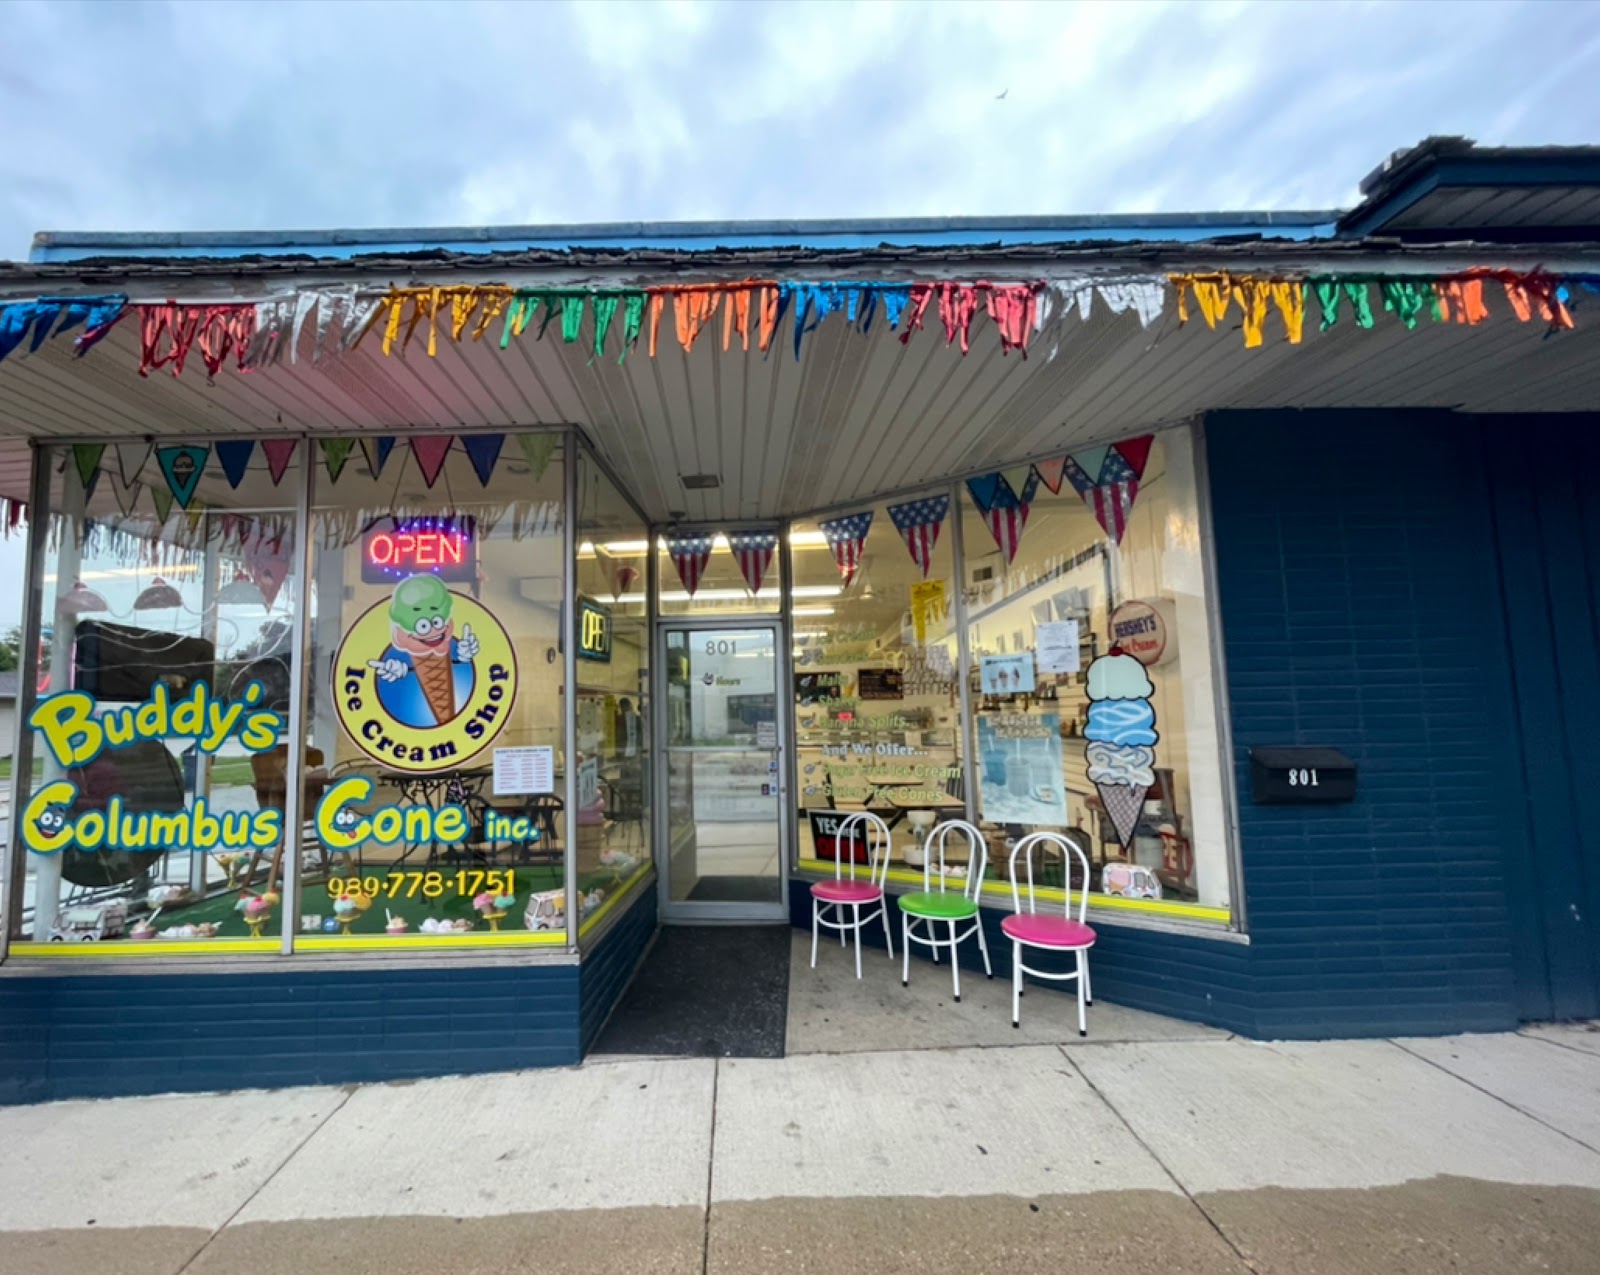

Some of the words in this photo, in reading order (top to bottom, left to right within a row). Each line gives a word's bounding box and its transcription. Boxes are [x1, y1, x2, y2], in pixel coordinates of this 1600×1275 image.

[369, 533, 464, 564] OPEN
[705, 640, 737, 656] 801
[344, 666, 366, 712] Ice
[361, 718, 457, 763] Cream
[464, 663, 509, 741] Shop
[29, 682, 282, 767] Buddy's
[822, 742, 849, 756] And
[851, 742, 873, 756] We
[914, 763, 961, 779] Cream
[1288, 768, 1319, 787] 801
[898, 787, 944, 801] Cones
[22, 780, 282, 852] Columbus
[317, 777, 468, 848] Cone
[486, 810, 540, 841] inc.
